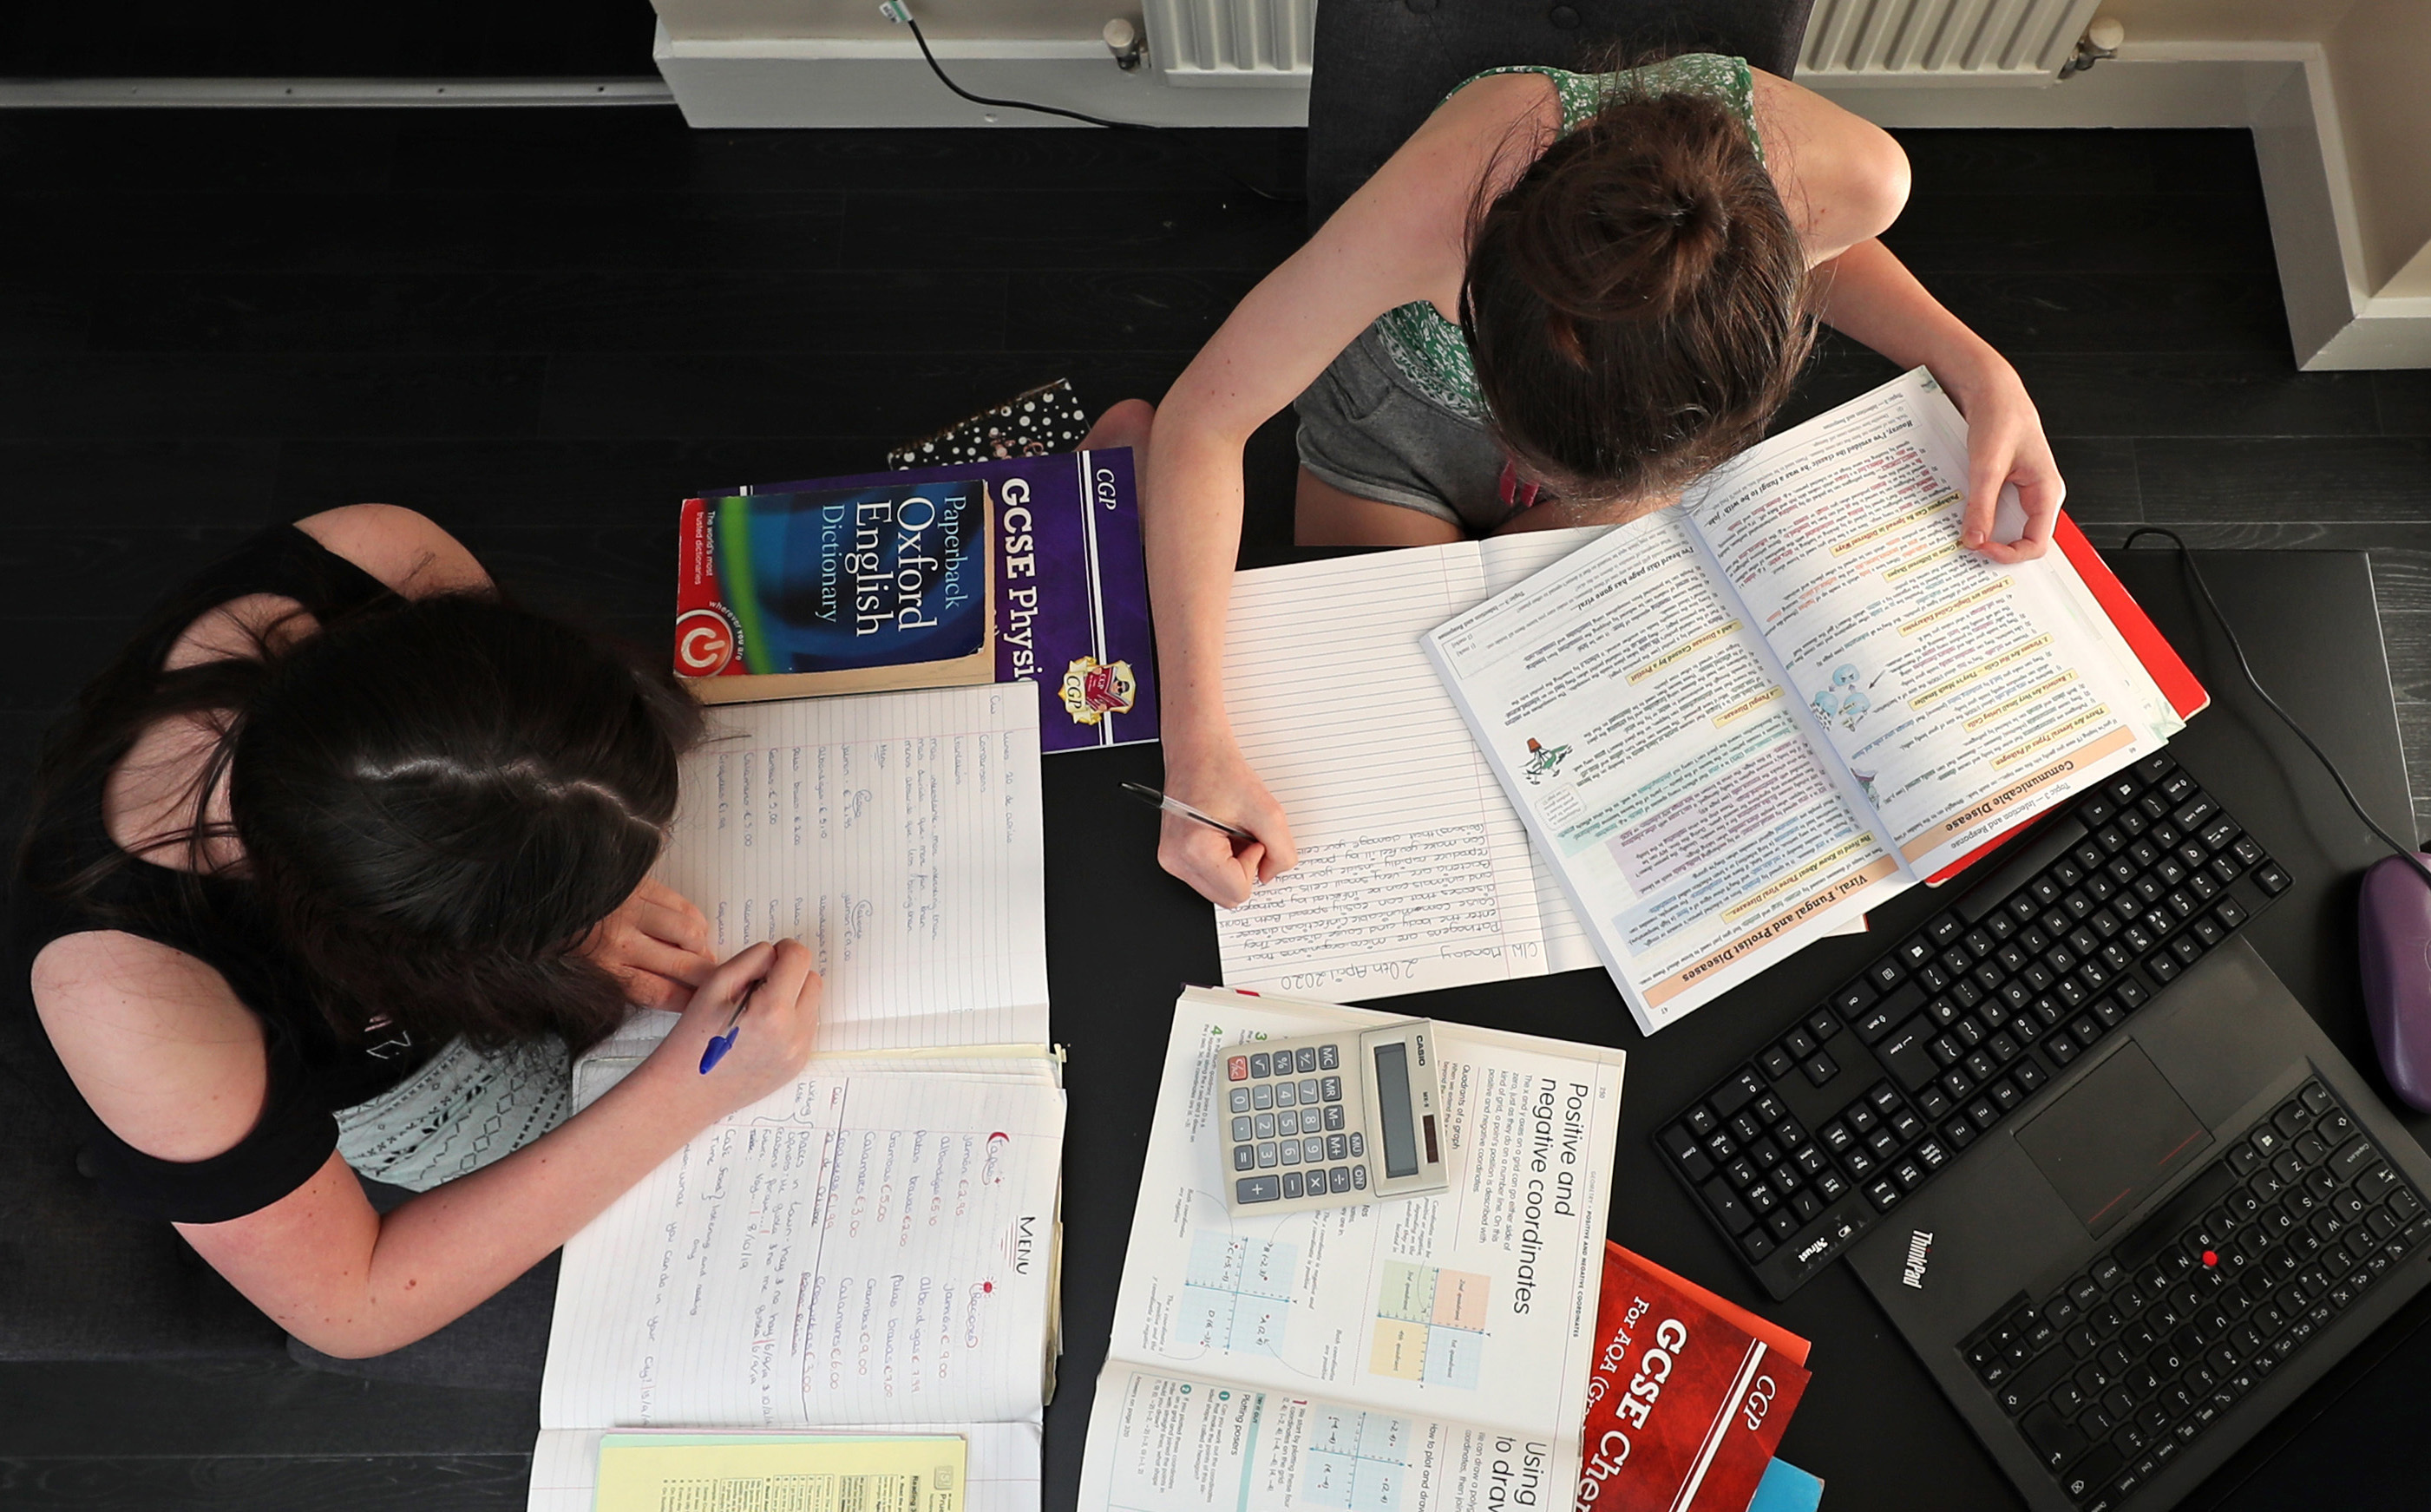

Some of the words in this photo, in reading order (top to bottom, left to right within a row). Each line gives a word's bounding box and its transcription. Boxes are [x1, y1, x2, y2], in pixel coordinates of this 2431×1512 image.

[1095, 467, 1117, 511] CGP
[706, 511, 715, 525] The
[999, 476, 1036, 579] GCSE
[705, 527, 714, 554] world's
[938, 494, 970, 610] Paperback
[693, 540, 703, 585] dictionaries
[811, 503, 847, 623] Dictionary
[842, 500, 894, 638] English
[894, 496, 939, 632] Oxford
[707, 600, 741, 628] wherever
[734, 646, 744, 661] are
[1006, 585, 1042, 684] Physi
[1065, 674, 1082, 710] CGP
[1990, 756, 2075, 810] Communicable
[2041, 789, 2051, 800] 3
[2047, 779, 2070, 797] Topic
[1943, 800, 1993, 835] Disease
[1986, 815, 2004, 830] and
[2002, 797, 2036, 822] Infection
[1948, 822, 1989, 851] Response
[1832, 869, 1869, 899] Viral,
[1792, 887, 1836, 920] Fungal
[1425, 918, 1500, 942] Pathogens
[1771, 912, 1796, 933] and
[1396, 931, 1418, 944] are
[1438, 938, 1502, 965] Monday
[1731, 925, 1773, 955] Protist
[1328, 962, 1368, 984] April
[1371, 956, 1421, 983] 20th
[1680, 947, 1734, 985] Diseases
[1279, 969, 1327, 992] 2020
[1320, 1047, 1333, 1066] MC
[1415, 1034, 1425, 1066] CASIO
[1279, 1090, 1289, 1099] 4
[1324, 1078, 1336, 1097] MR
[1456, 1064, 1471, 1106] Quadrants
[1523, 1074, 1532, 1088] The
[1233, 1096, 1243, 1104] 0
[1456, 1107, 1465, 1116] of
[1520, 1095, 1530, 1109] and
[1258, 1121, 1269, 1129] 2
[1281, 1118, 1292, 1127] 5
[1304, 1115, 1315, 1124] 8
[1517, 1117, 1525, 1136] axes
[1523, 1077, 1561, 1174] negative
[1557, 1082, 1589, 1166] Positive
[1307, 1144, 1318, 1154] 9
[1350, 1136, 1361, 1153] MU
[1448, 1124, 1462, 1149] graph
[1260, 1150, 1272, 1159] 3
[1284, 1147, 1295, 1156] 6
[1510, 1155, 1522, 1172] grid
[1353, 1168, 1365, 1186] ON
[1510, 1173, 1518, 1188] can
[1552, 1170, 1580, 1217] and
[1505, 1201, 1517, 1223] either
[1582, 1209, 1593, 1240] POSITIVE
[1014, 1215, 1036, 1275] MENU
[1504, 1224, 1513, 1240] side
[1510, 1178, 1550, 1316] coordinates
[1796, 1241, 1822, 1264] Trust
[1900, 1227, 1933, 1289] ThinkPad
[1576, 1257, 1588, 1289] NEGATIVE
[1570, 1290, 1584, 1339] COORDINATES
[1622, 1295, 1650, 1329] For
[1599, 1327, 1633, 1374] AQA
[1615, 1318, 1689, 1431] GCSE
[1234, 1392, 1248, 1424] Plotting
[1742, 1374, 1777, 1431] CGP
[1229, 1424, 1243, 1456] posers
[1512, 1440, 1546, 1507] Using
